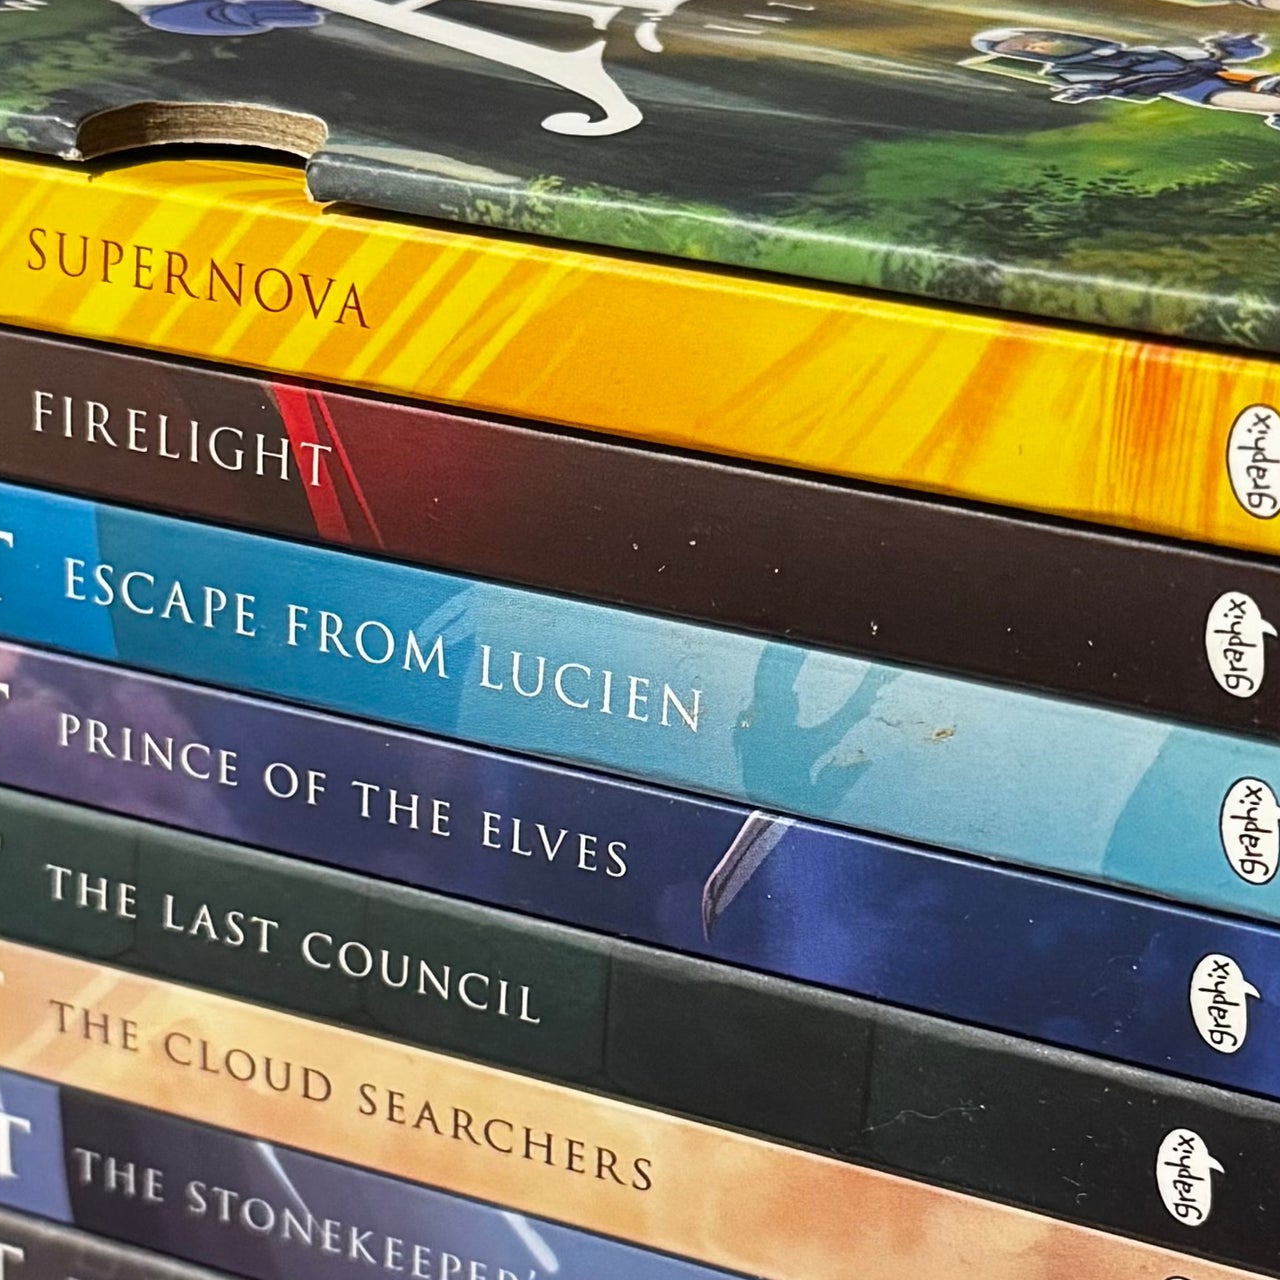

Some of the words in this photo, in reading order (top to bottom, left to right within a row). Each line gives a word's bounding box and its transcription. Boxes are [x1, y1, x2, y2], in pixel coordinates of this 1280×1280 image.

[26, 226, 371, 330] SUPERNOVA
[31, 390, 332, 488] FIRELIGHT
[1237, 412, 1277, 511] graphix
[64, 556, 258, 637] ESCAPE
[286, 604, 450, 679] FROM
[479, 643, 705, 733] LUCIEN
[1213, 597, 1255, 692] graphix
[57, 713, 240, 786] PRINCE
[263, 762, 328, 805] OF
[351, 781, 452, 838] THE
[481, 812, 630, 879] ELVES
[1228, 783, 1270, 879] graphix
[45, 862, 137, 920] THE
[162, 895, 280, 954] LAST
[300, 932, 542, 1024] COUNCIL
[1197, 959, 1238, 1049] graphix
[49, 998, 140, 1054] THE
[163, 1030, 333, 1103] CLOUD
[357, 1083, 654, 1191] SEARCHERS
[72, 1146, 166, 1204] THE
[1164, 1134, 1204, 1221] graphix
